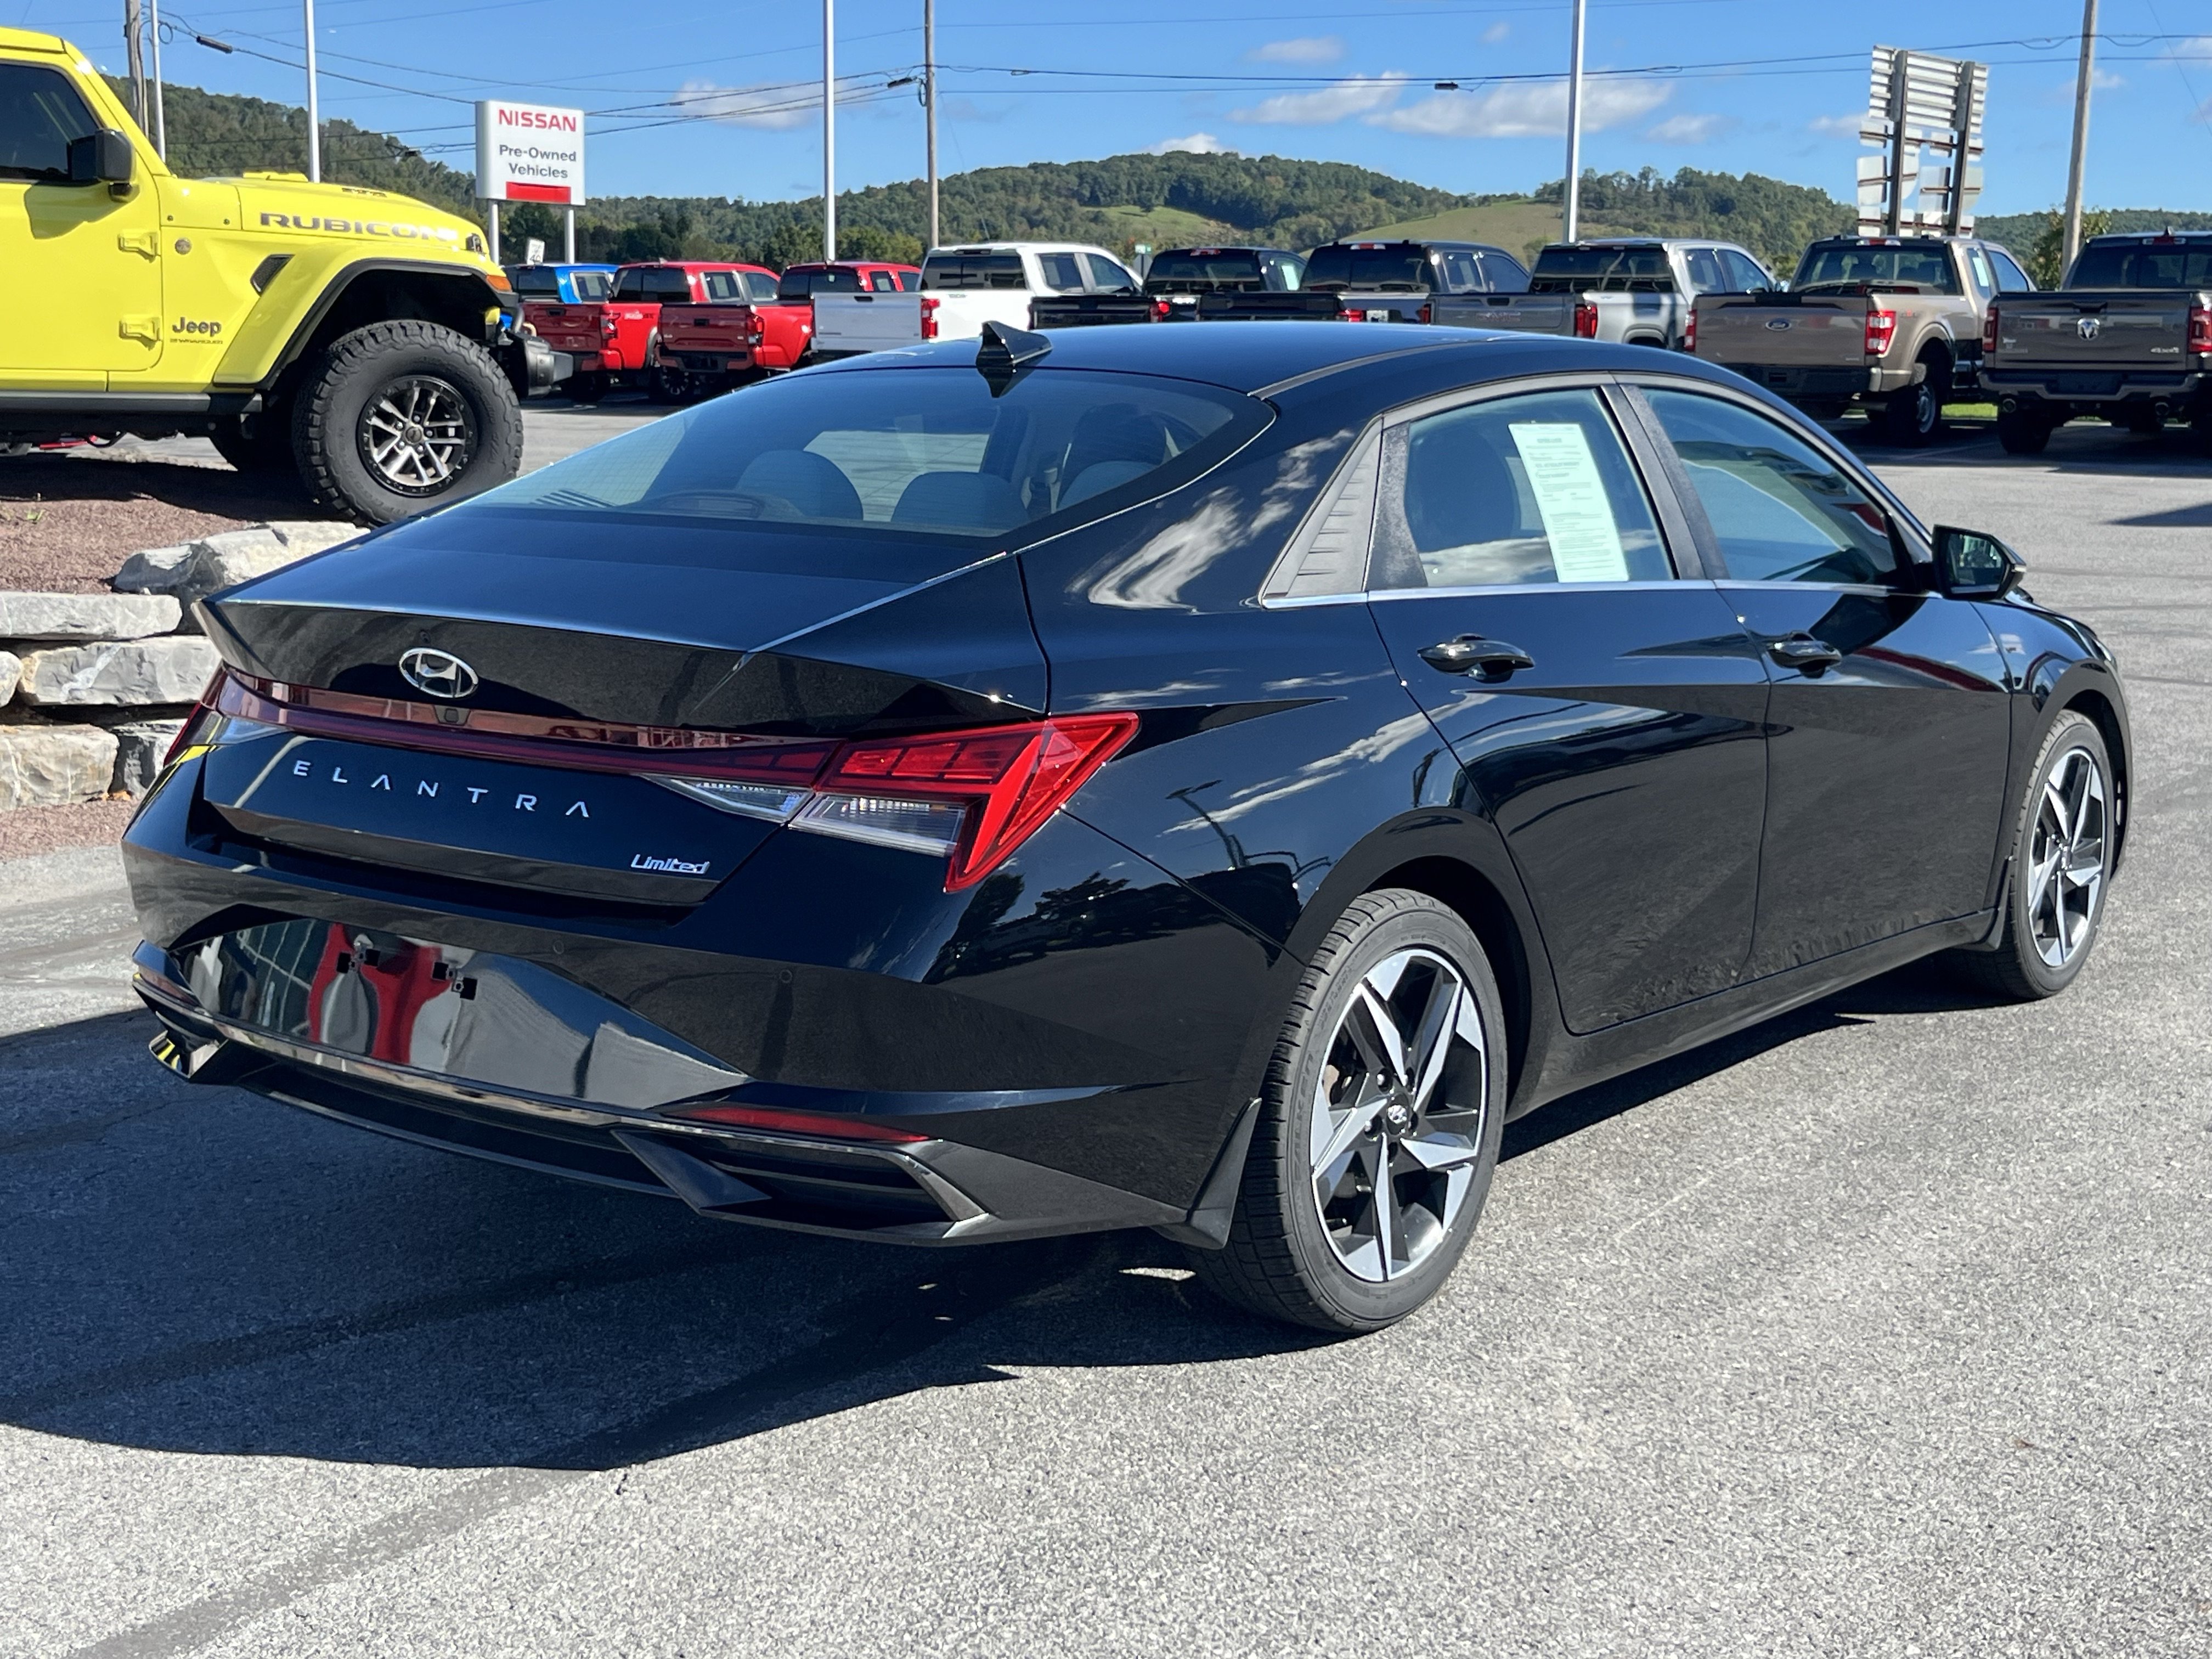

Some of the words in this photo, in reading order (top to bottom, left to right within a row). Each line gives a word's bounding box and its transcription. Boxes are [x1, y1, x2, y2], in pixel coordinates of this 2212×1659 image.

[498, 109, 576, 132] NISSAN
[499, 145, 577, 162] Pre-Owned
[509, 163, 568, 178] Vehicles
[260, 212, 458, 242] RUBICON
[172, 317, 222, 337] Jeep
[294, 759, 590, 818] ELANTRA
[630, 854, 710, 874] Limited
